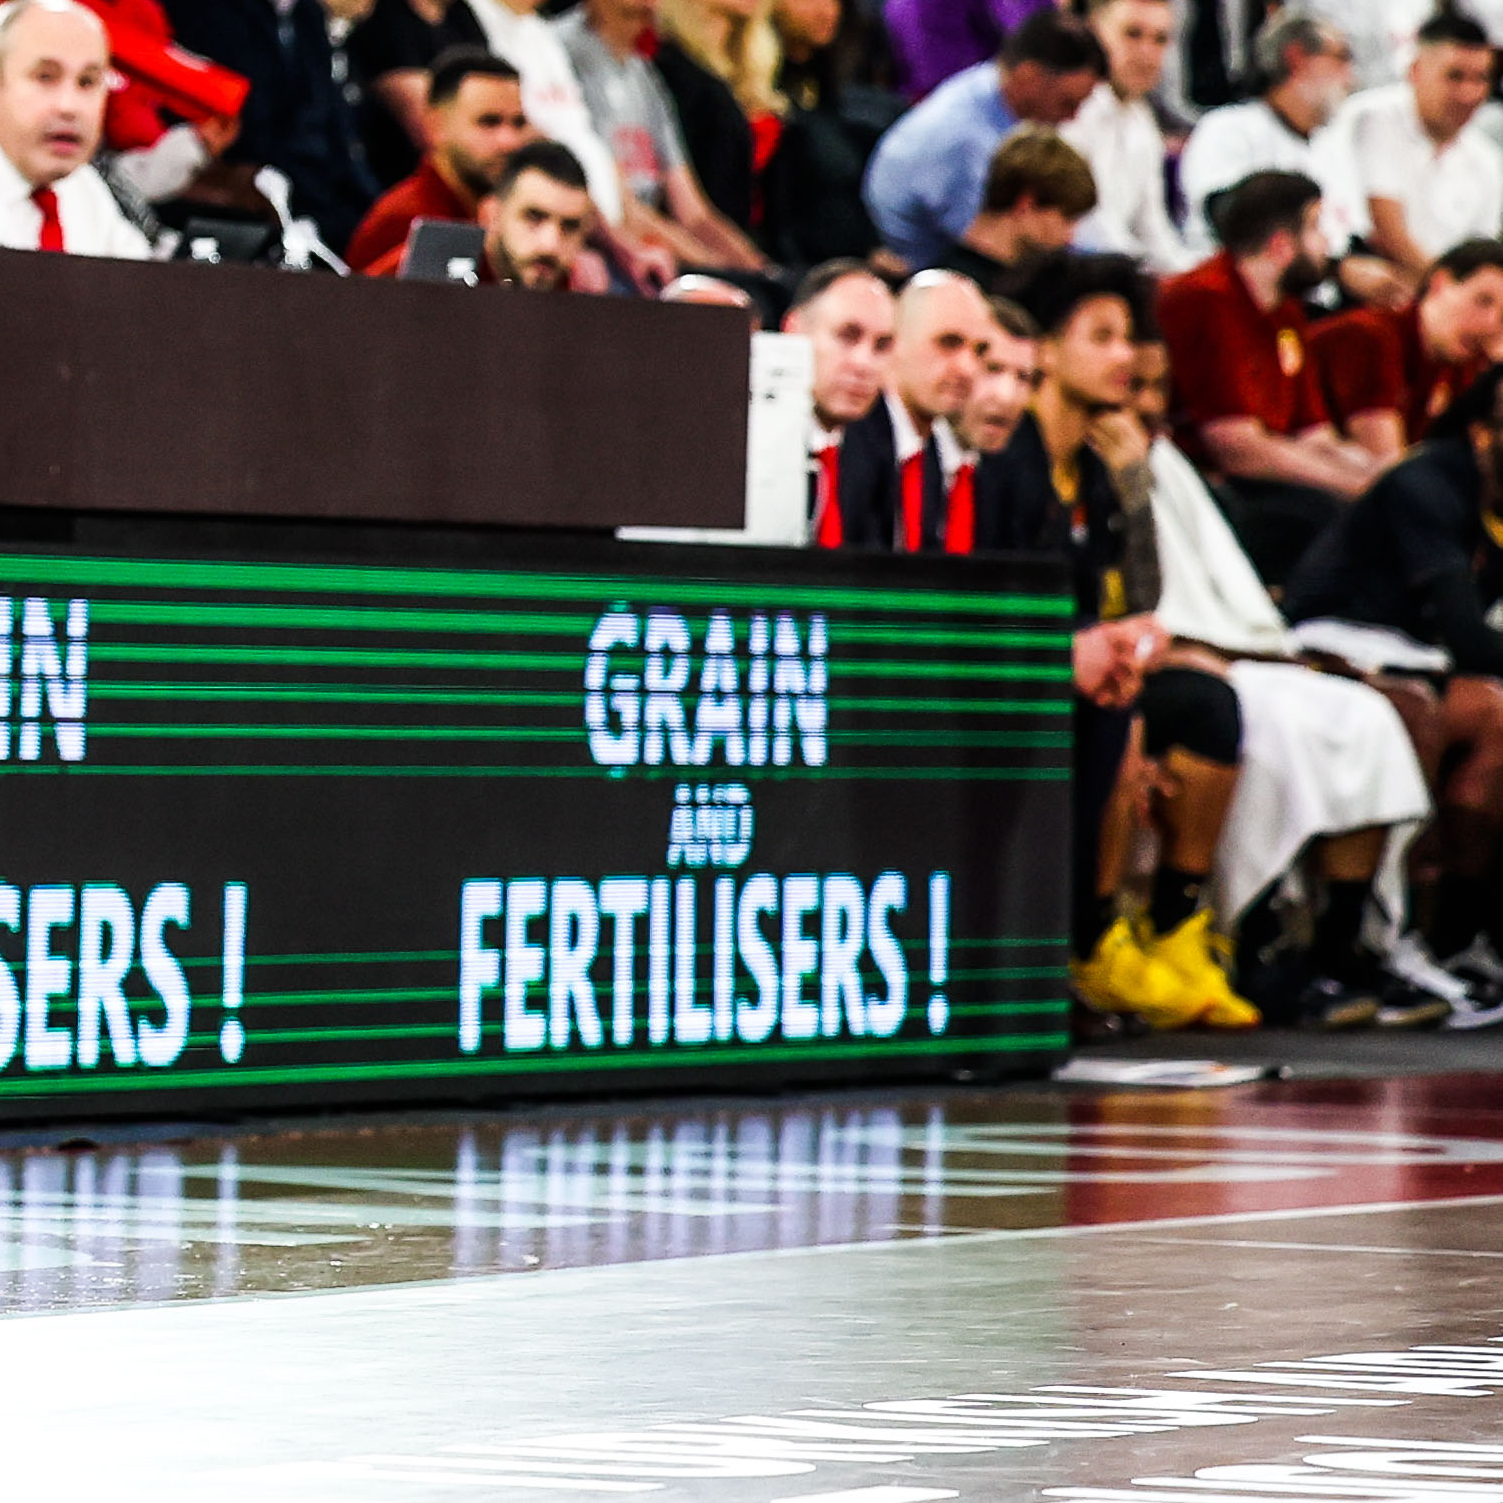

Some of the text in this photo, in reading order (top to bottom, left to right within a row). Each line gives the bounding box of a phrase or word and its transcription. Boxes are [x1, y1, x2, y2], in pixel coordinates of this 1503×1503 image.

[584, 609, 829, 767] GRAIN
[666, 783, 755, 868] AND
[458, 869, 908, 1054] FERTILISERS
[164, 1384, 1412, 1492] TURKISH
